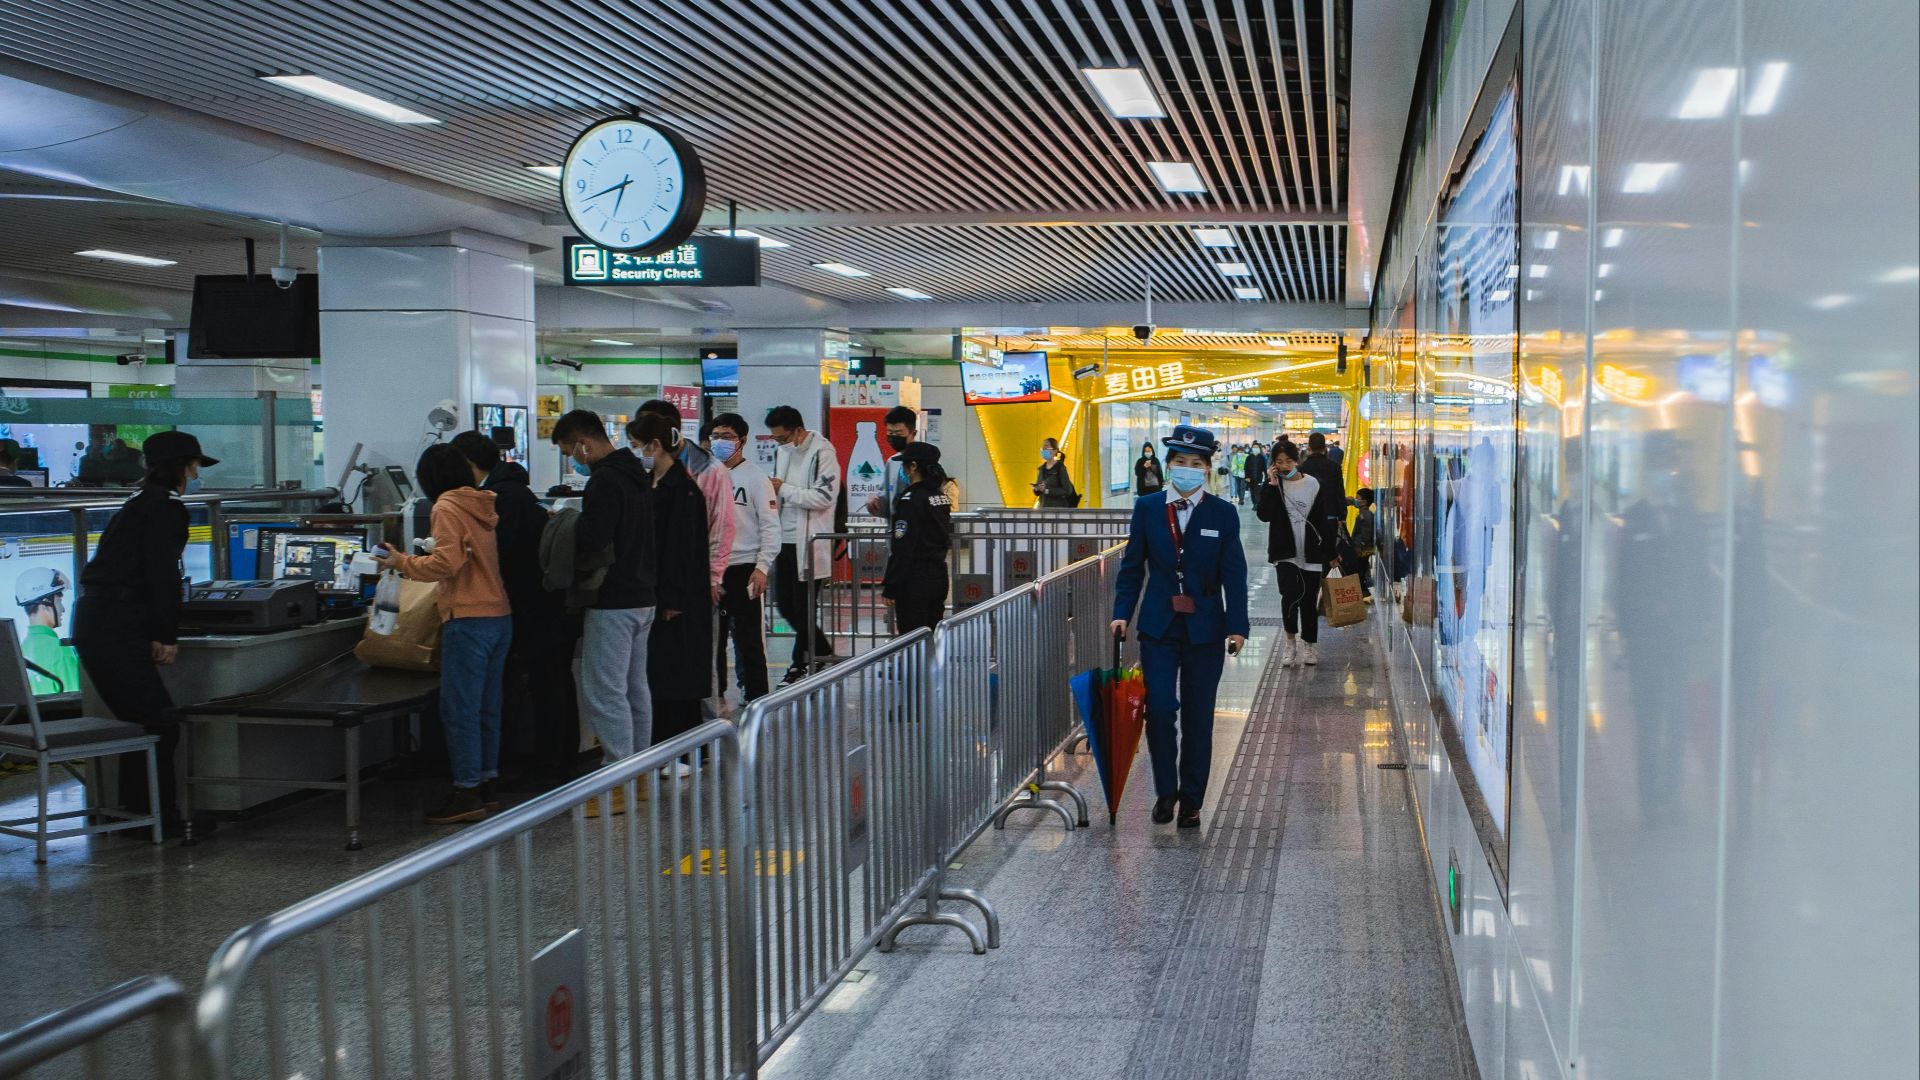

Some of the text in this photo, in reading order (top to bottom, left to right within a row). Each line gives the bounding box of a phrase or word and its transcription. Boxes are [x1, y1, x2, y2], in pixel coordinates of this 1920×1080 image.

[616, 129, 633, 144] 12
[576, 179, 586, 194] 9
[664, 178, 674, 193] 3
[620, 228, 630, 243] 6
[611, 268, 702, 280] Security Check
[1104, 362, 1185, 395] 麦田里
[1181, 378, 1260, 399] 地铁商业街
